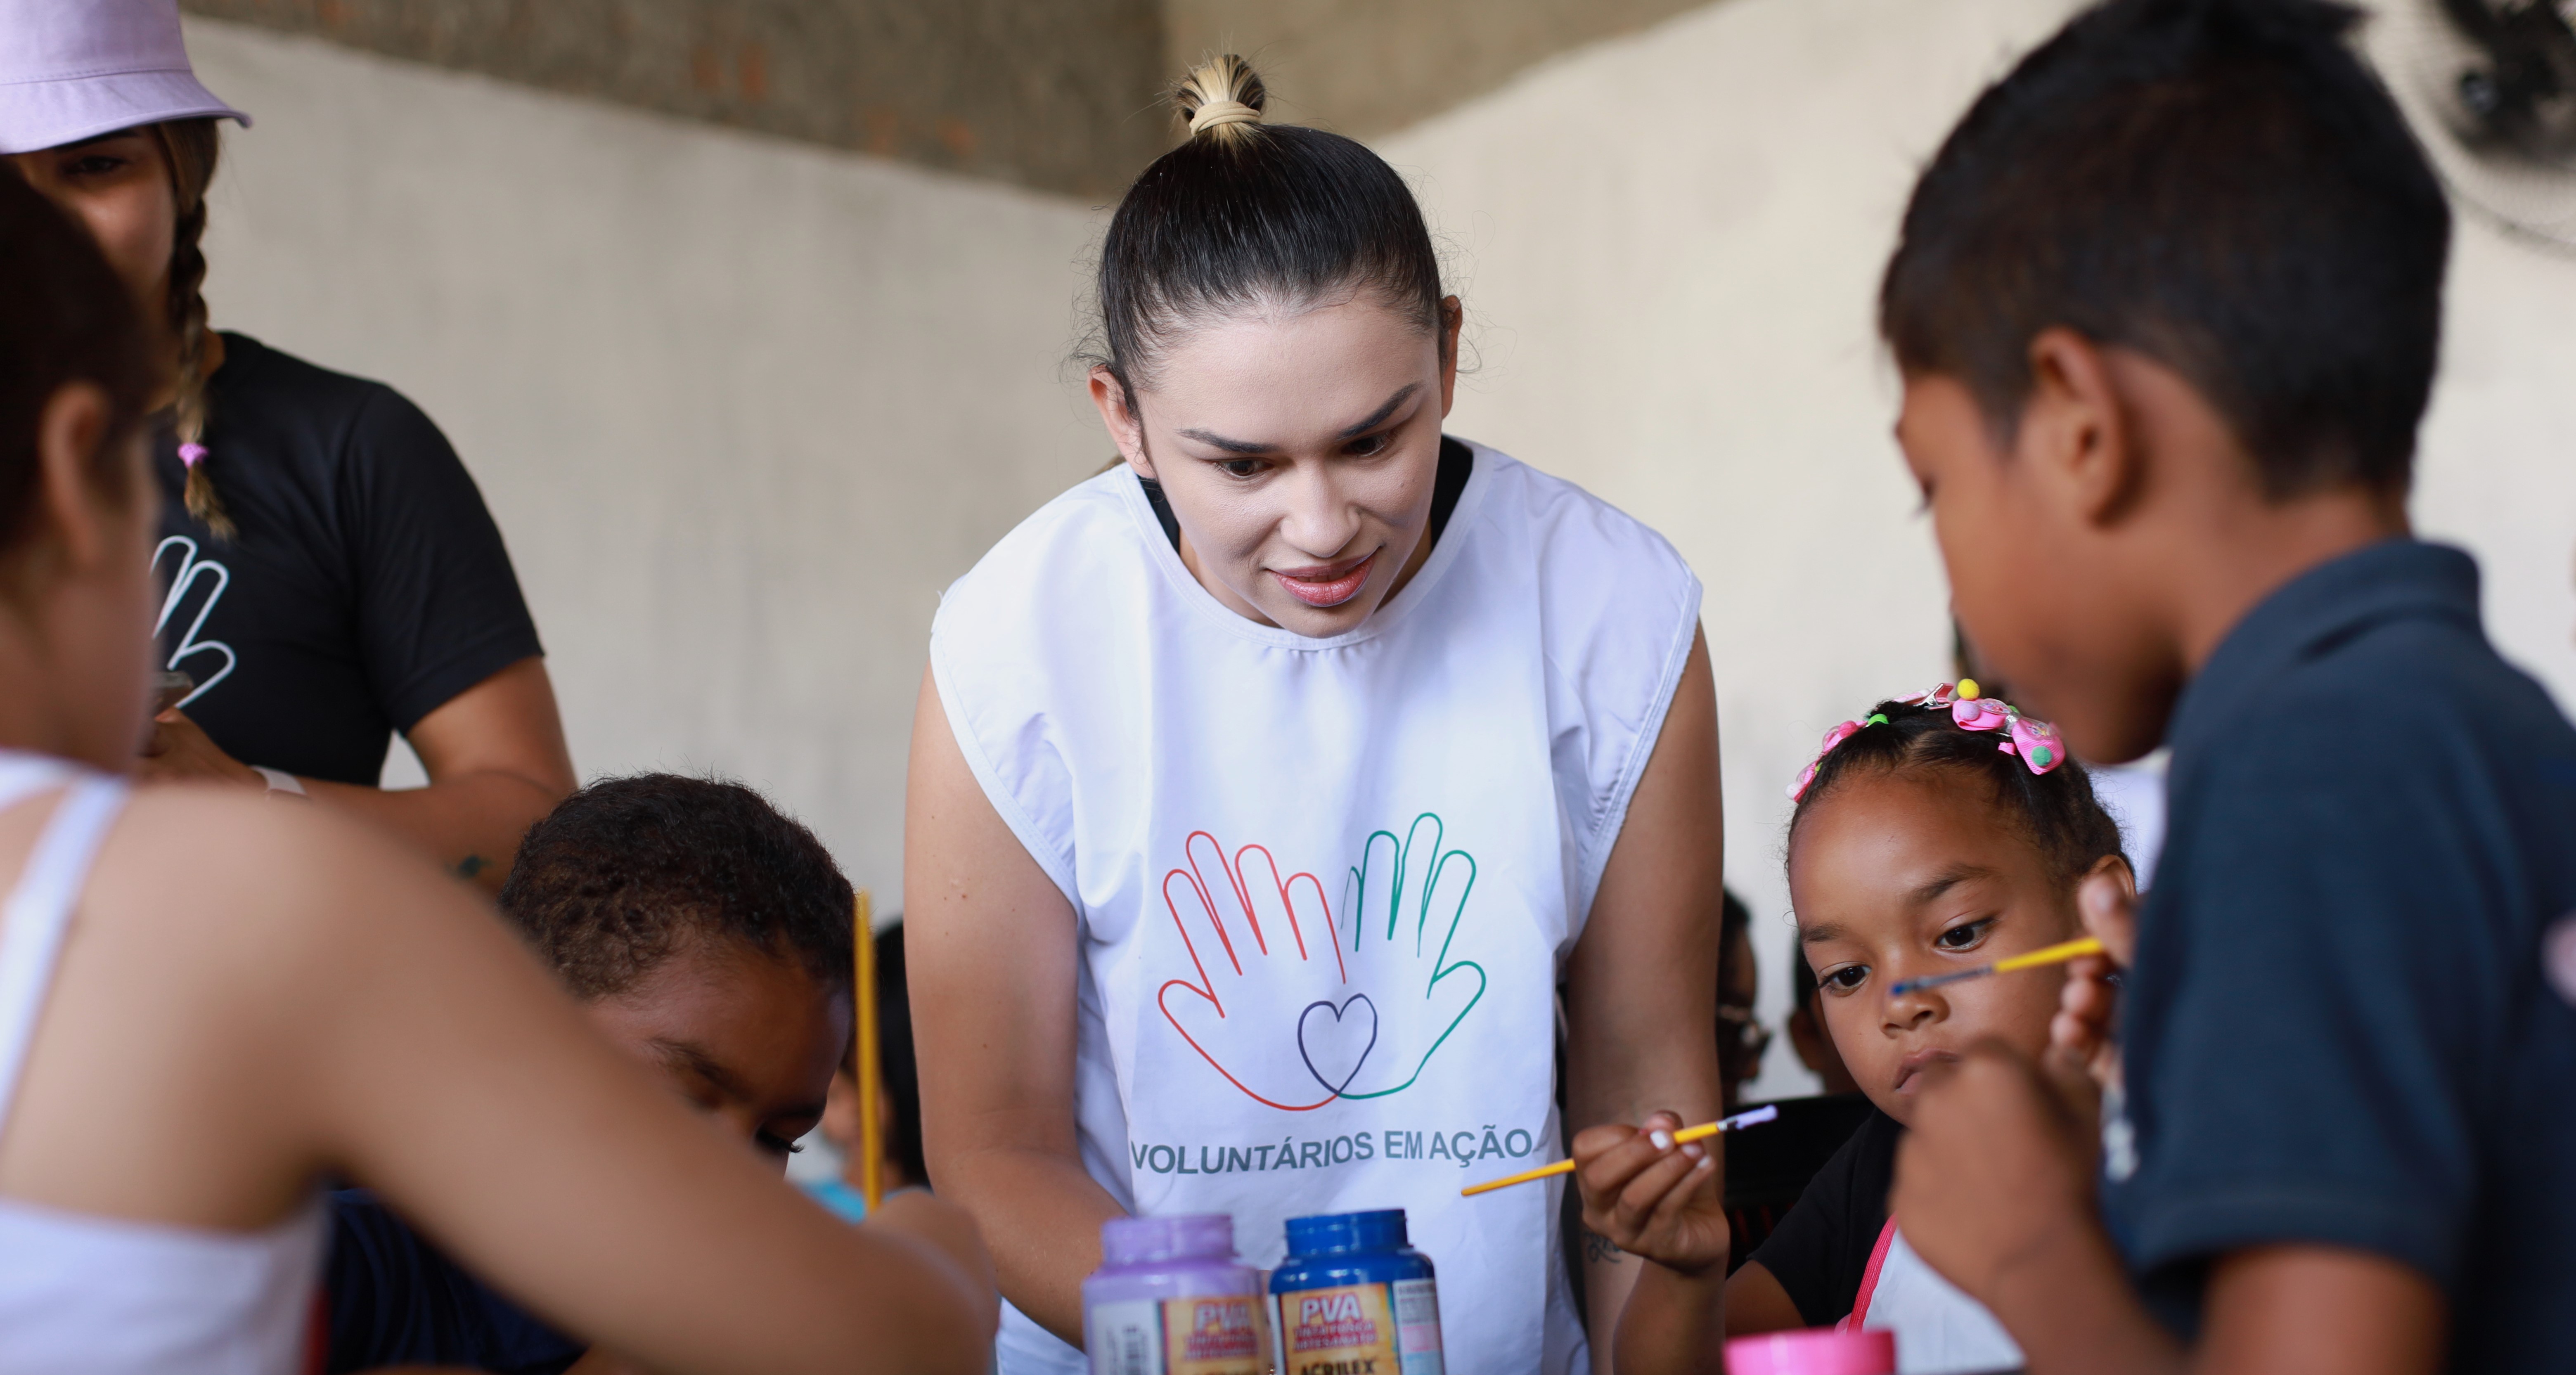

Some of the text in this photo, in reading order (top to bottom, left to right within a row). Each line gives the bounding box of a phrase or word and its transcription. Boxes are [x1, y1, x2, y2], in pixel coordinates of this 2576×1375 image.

[1131, 1124, 1532, 1174] VOLUNTÁRIOS EM AÇÃO
[1301, 1295, 1361, 1325] PVA
